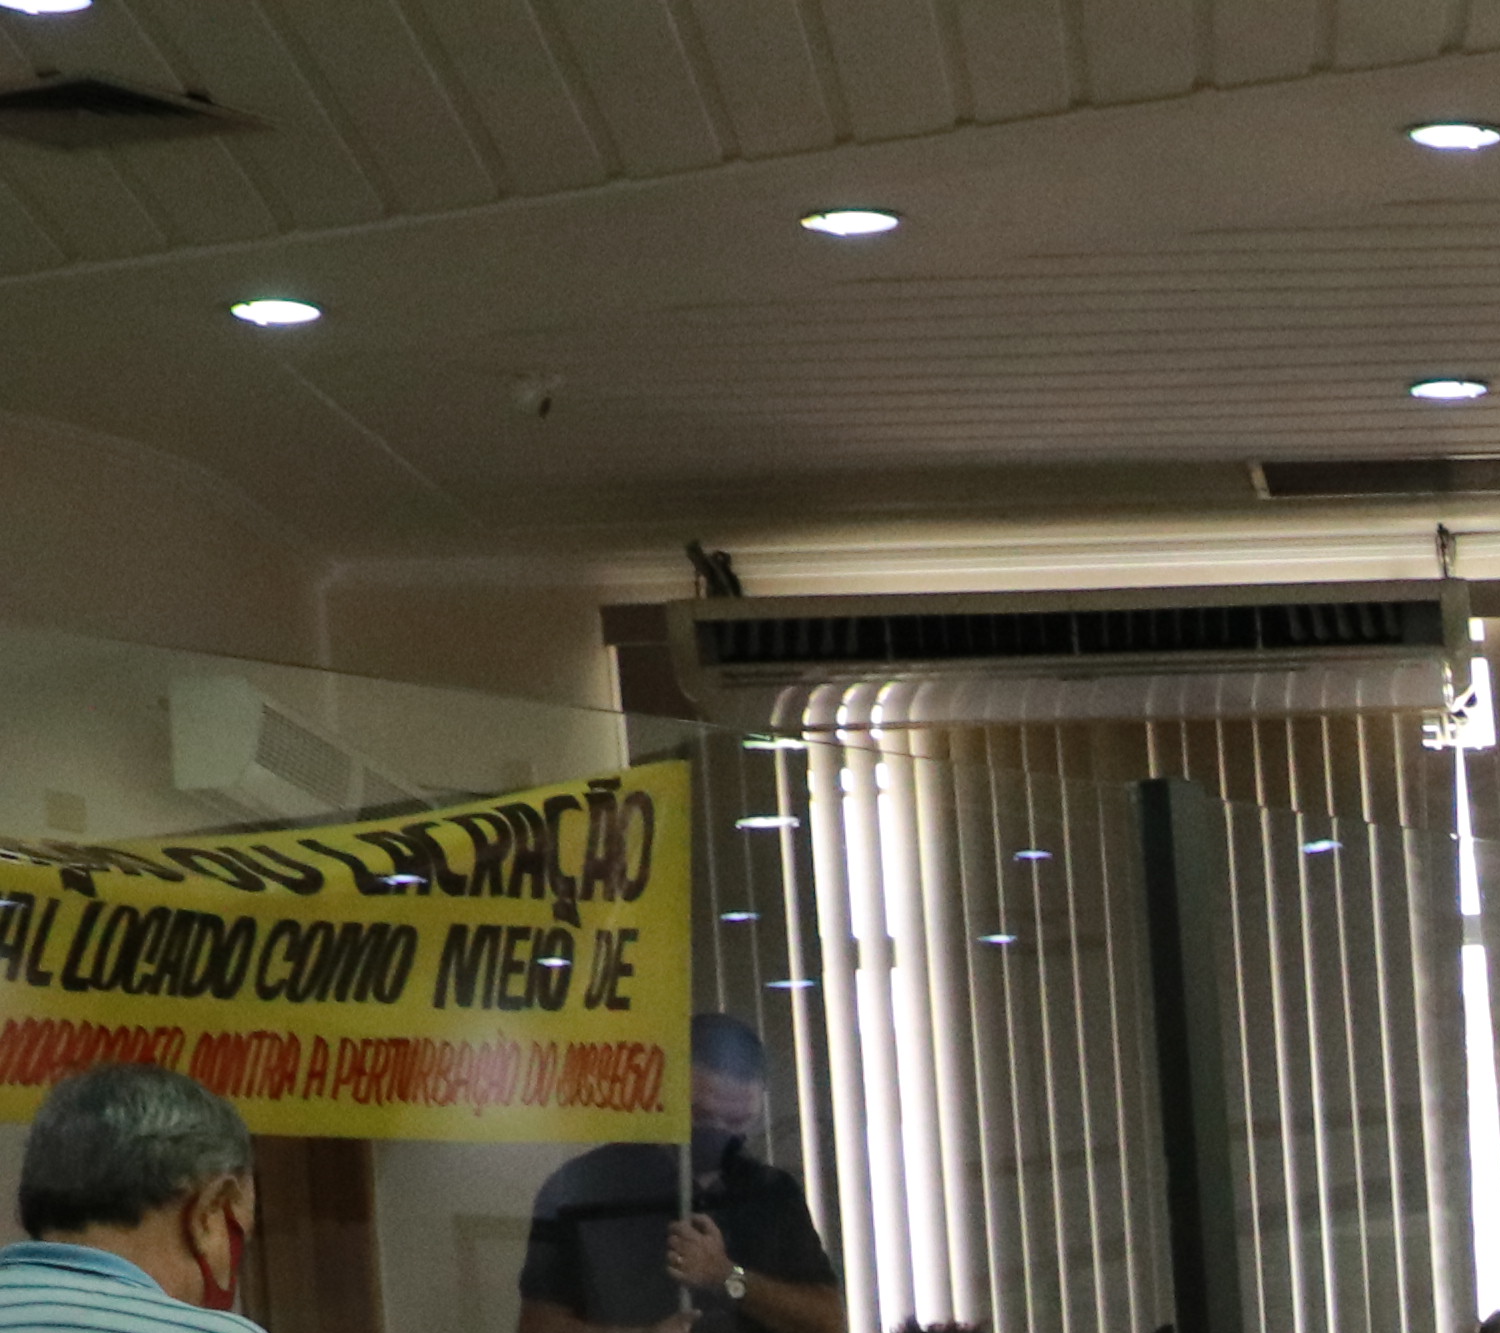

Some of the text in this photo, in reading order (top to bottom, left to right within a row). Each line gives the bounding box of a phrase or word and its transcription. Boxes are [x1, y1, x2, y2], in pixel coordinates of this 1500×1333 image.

[161, 837, 325, 896] OU
[298, 776, 655, 929] LACRAÇÃO
[60, 900, 257, 1001] LOCADO
[255, 919, 418, 1005] COMO
[433, 922, 576, 1012] MEIO
[583, 927, 640, 1012] DE
[303, 1034, 330, 1100] A
[519, 1040, 559, 1099] DO
